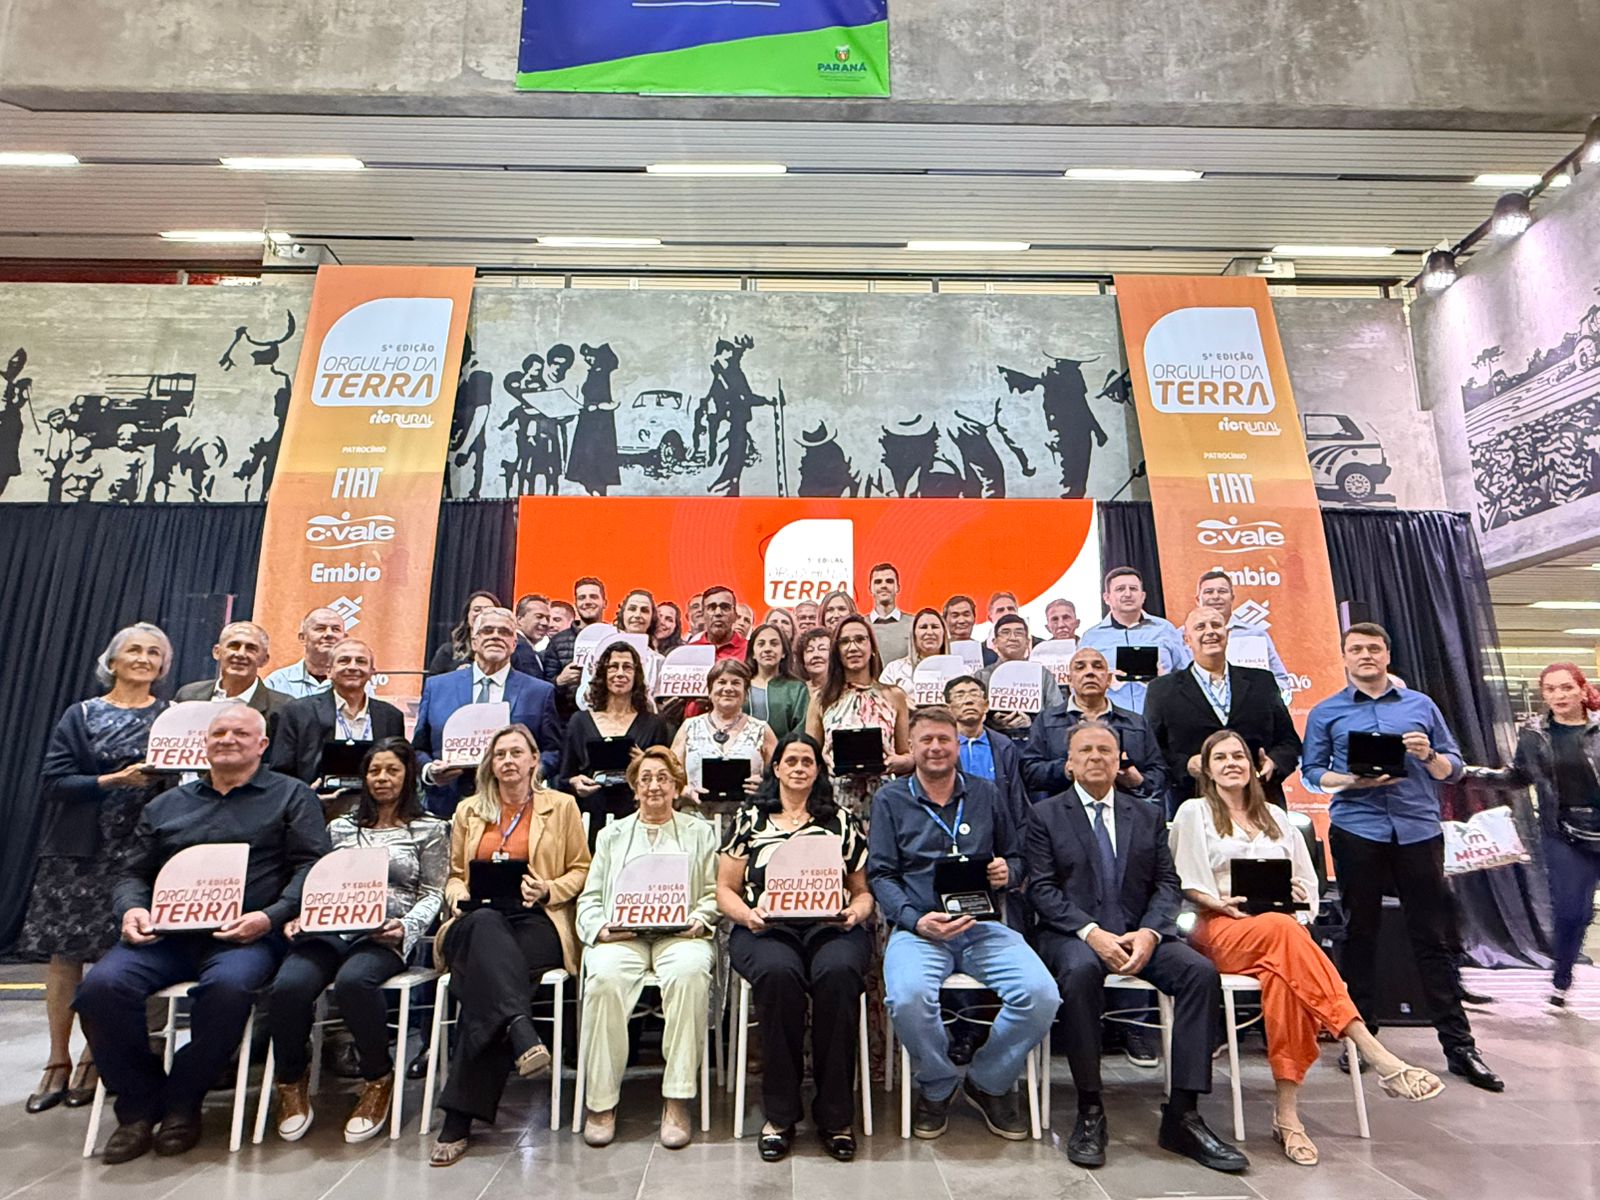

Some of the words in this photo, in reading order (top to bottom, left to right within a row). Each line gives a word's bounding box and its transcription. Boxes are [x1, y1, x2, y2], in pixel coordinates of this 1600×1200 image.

[817, 62, 867, 71] PARANÁ
[396, 343, 435, 353] EDIÇÃO
[323, 356, 410, 371] ORGULHO
[413, 356, 437, 371] DA
[1216, 352, 1254, 362] EDIÇÃO
[1153, 364, 1235, 379] ORGULHO
[1240, 364, 1264, 379] DA
[320, 373, 434, 398] TERRA
[1155, 381, 1270, 406] TERRA
[331, 467, 384, 498] FIAT
[1207, 473, 1256, 504] FIAT
[310, 562, 381, 583] Embio
[1211, 566, 1280, 586] mbio
[991, 695, 1039, 710] TERRA
[151, 748, 208, 765] TERR
[767, 878, 823, 890] ORGULHO
[824, 878, 840, 890] DA
[156, 888, 221, 903] ORGULHO
[223, 888, 241, 901] DA
[304, 891, 365, 906] ORGULHO
[367, 890, 384, 903] DA
[615, 892, 669, 904] ORGULHO
[671, 892, 686, 904] DA
[767, 891, 840, 911] TERRA
[155, 901, 239, 924] TERRA
[304, 903, 382, 926] TERRA
[615, 905, 686, 923] TERRA
